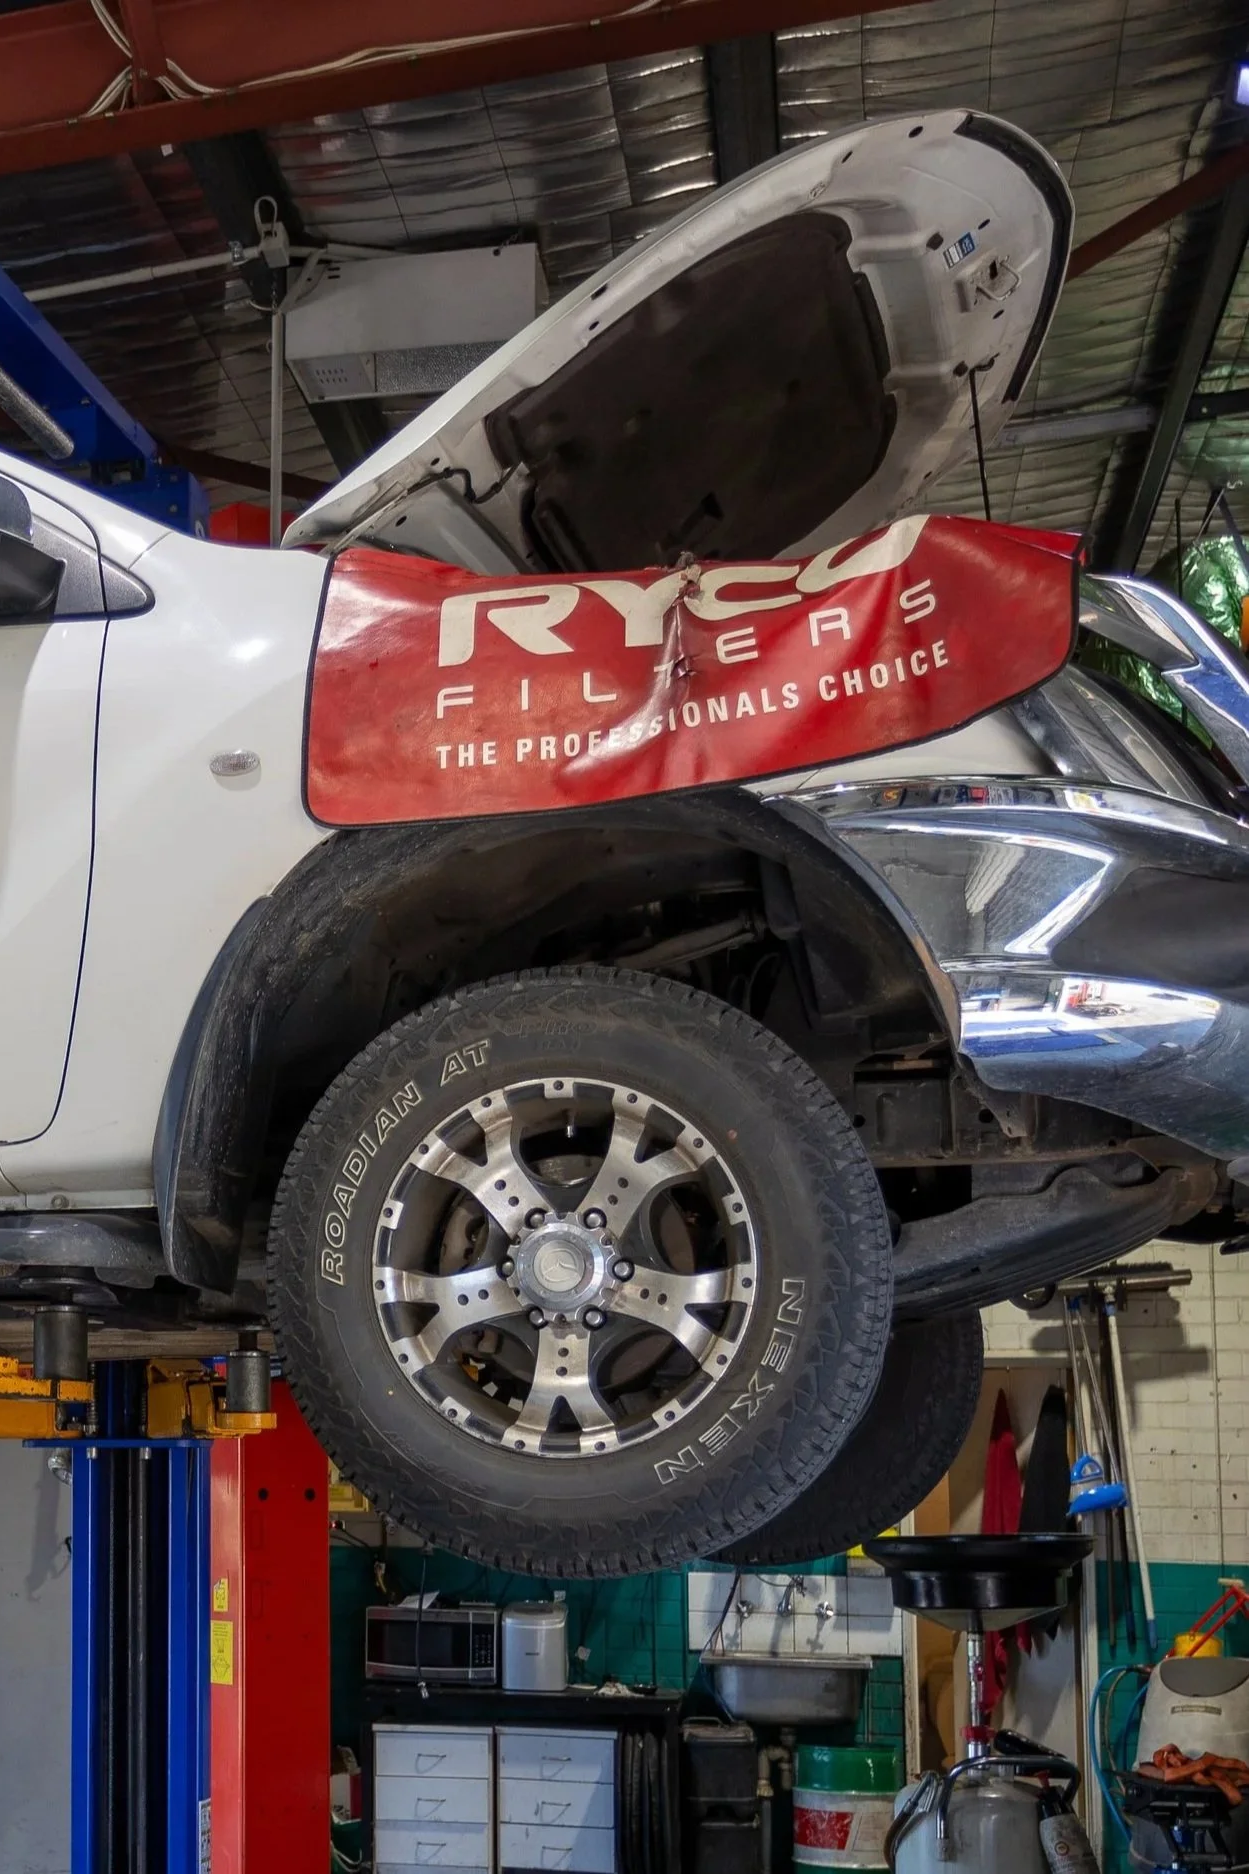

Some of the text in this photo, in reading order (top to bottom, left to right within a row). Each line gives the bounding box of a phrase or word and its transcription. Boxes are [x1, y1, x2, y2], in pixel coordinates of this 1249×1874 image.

[437, 580, 938, 719] FILTERS
[439, 514, 930, 667] RYCO
[436, 640, 950, 770] THE PROFESSIONALS CHOICE
[321, 1039, 490, 1286] ROADIAN AT
[653, 1278, 806, 1486] NEXEN
